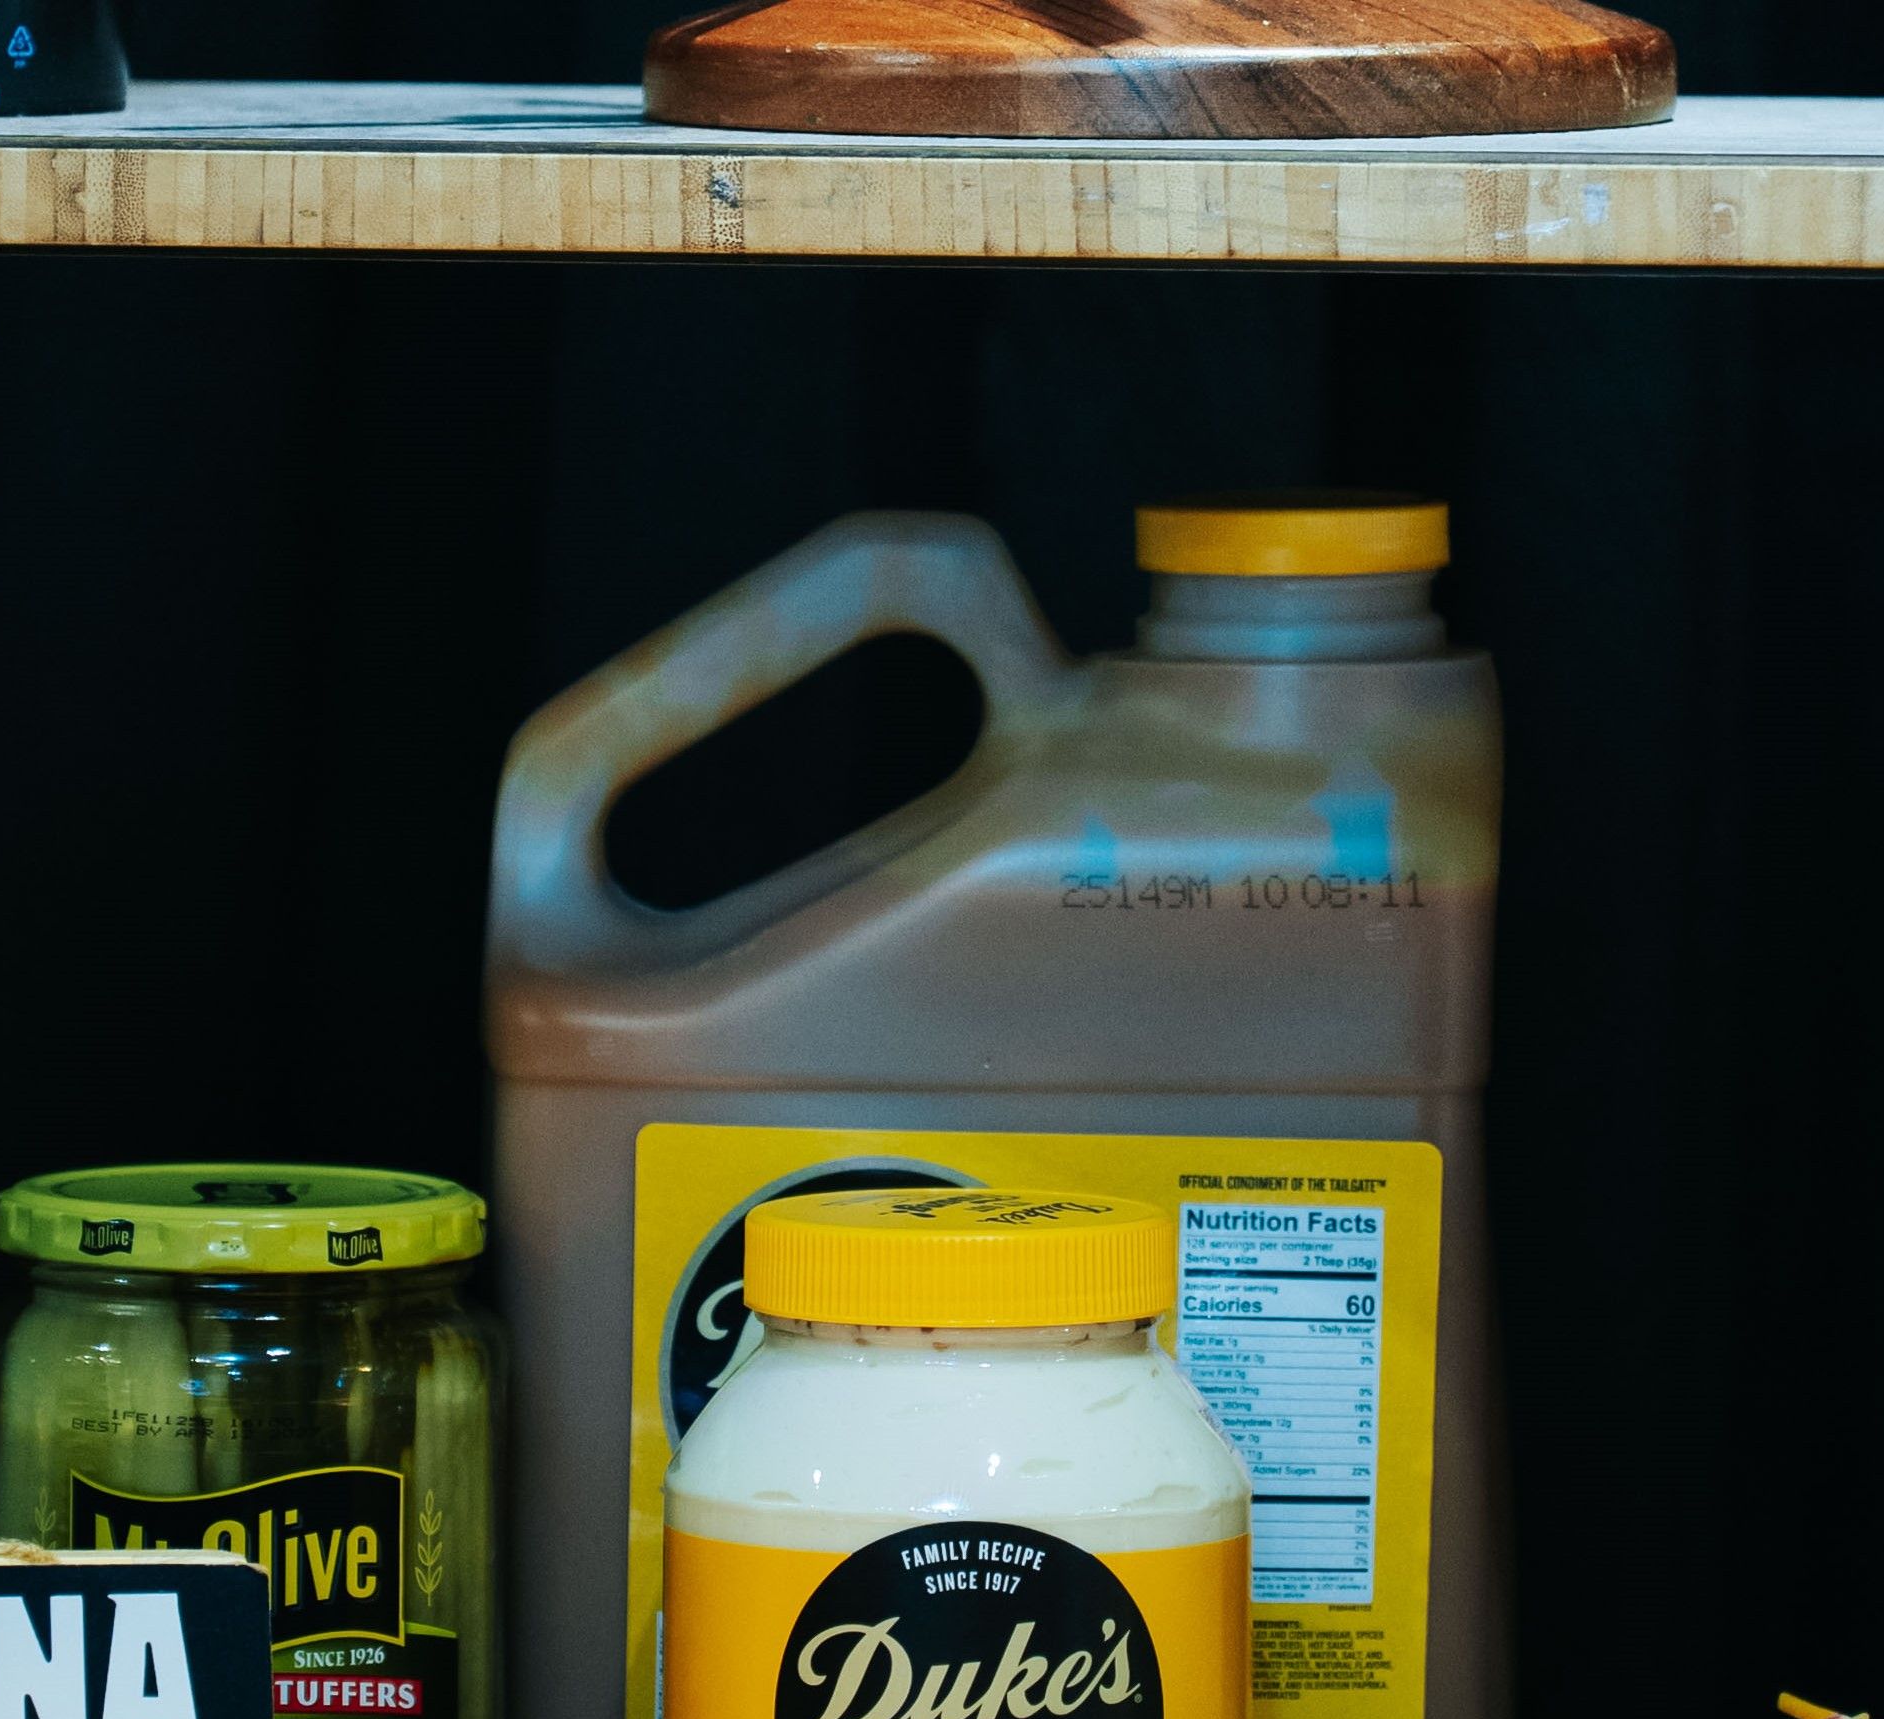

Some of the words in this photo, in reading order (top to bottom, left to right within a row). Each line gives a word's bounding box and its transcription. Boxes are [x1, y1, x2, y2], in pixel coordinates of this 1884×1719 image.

[1179, 1175, 1223, 1189] OFFICIAL
[1227, 1176, 1288, 1190] CONDIMENT
[1291, 1178, 1305, 1191] OF
[1307, 1178, 1326, 1192] THE
[1186, 1209, 1298, 1232] Nutrition
[1308, 1212, 1377, 1233] Facts
[97, 1224, 130, 1249] Olive
[332, 1239, 349, 1260] Mt.
[350, 1235, 379, 1258] Olive
[1259, 1243, 1278, 1252] per
[1281, 1241, 1334, 1252] container
[1185, 1253, 1230, 1266] Serving
[1234, 1255, 1258, 1264] size
[1303, 1257, 1310, 1266] 2
[1314, 1256, 1343, 1268] Tbsp
[1184, 1296, 1263, 1313] Calories
[1346, 1295, 1375, 1316] 60
[72, 1418, 122, 1433] BEST
[136, 1425, 162, 1437] BY
[901, 1540, 969, 1571] FAMILY
[978, 1541, 1046, 1571] RECIPE
[926, 1571, 978, 1594] SINCE
[985, 1572, 1021, 1595] 1917
[294, 1649, 345, 1669] SINCE
[350, 1646, 385, 1666] 1926
